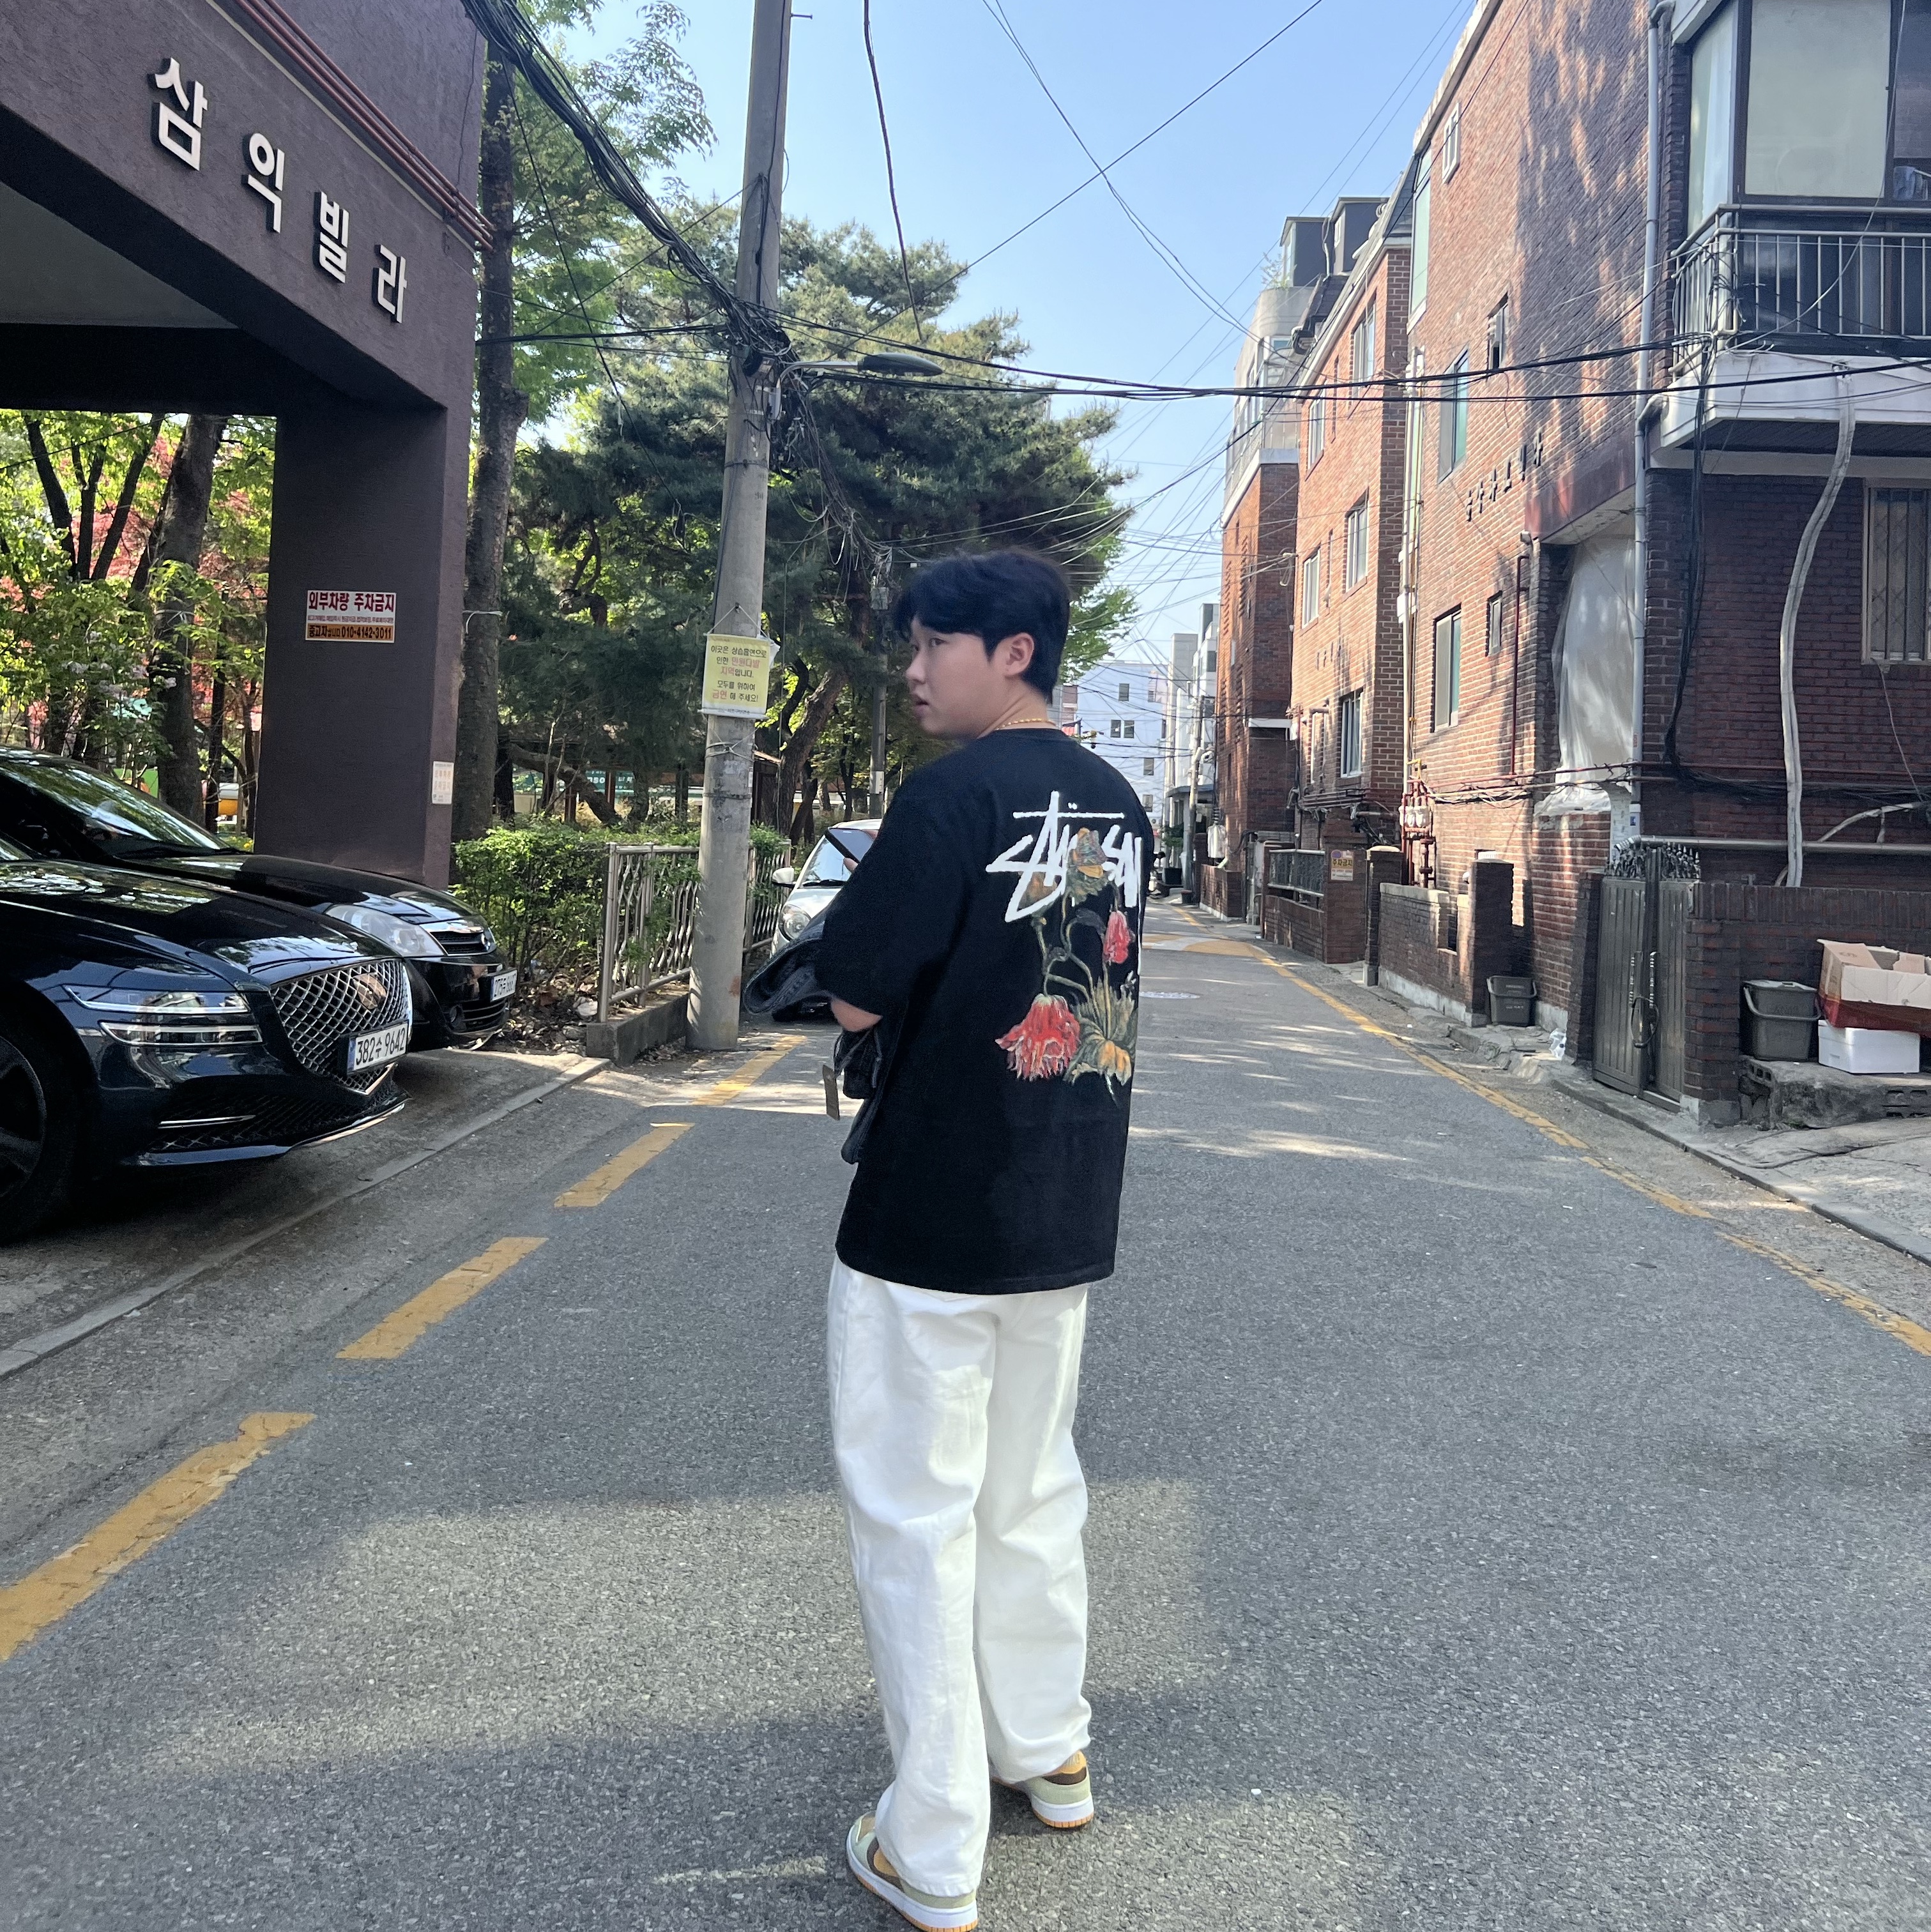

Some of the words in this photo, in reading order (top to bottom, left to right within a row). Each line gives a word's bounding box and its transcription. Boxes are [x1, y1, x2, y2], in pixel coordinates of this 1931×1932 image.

[154, 57, 408, 323] 삼익빌라
[309, 591, 349, 611] 외부차량
[354, 593, 395, 612] 주차금지
[711, 645, 729, 654] 이곳은
[731, 647, 767, 658] 상습흡연으로
[716, 657, 729, 665] 인한
[731, 657, 760, 669] 민원다발
[721, 666, 754, 678] 지역입니다.
[717, 680, 735, 689] 모두를
[737, 682, 756, 691] 위하여
[712, 689, 728, 699] 금연
[738, 693, 759, 702] 주세요!
[1332, 858, 1353, 867] 주차금지
[356, 1037, 383, 1065] 382수
[385, 1027, 406, 1057] 9642
